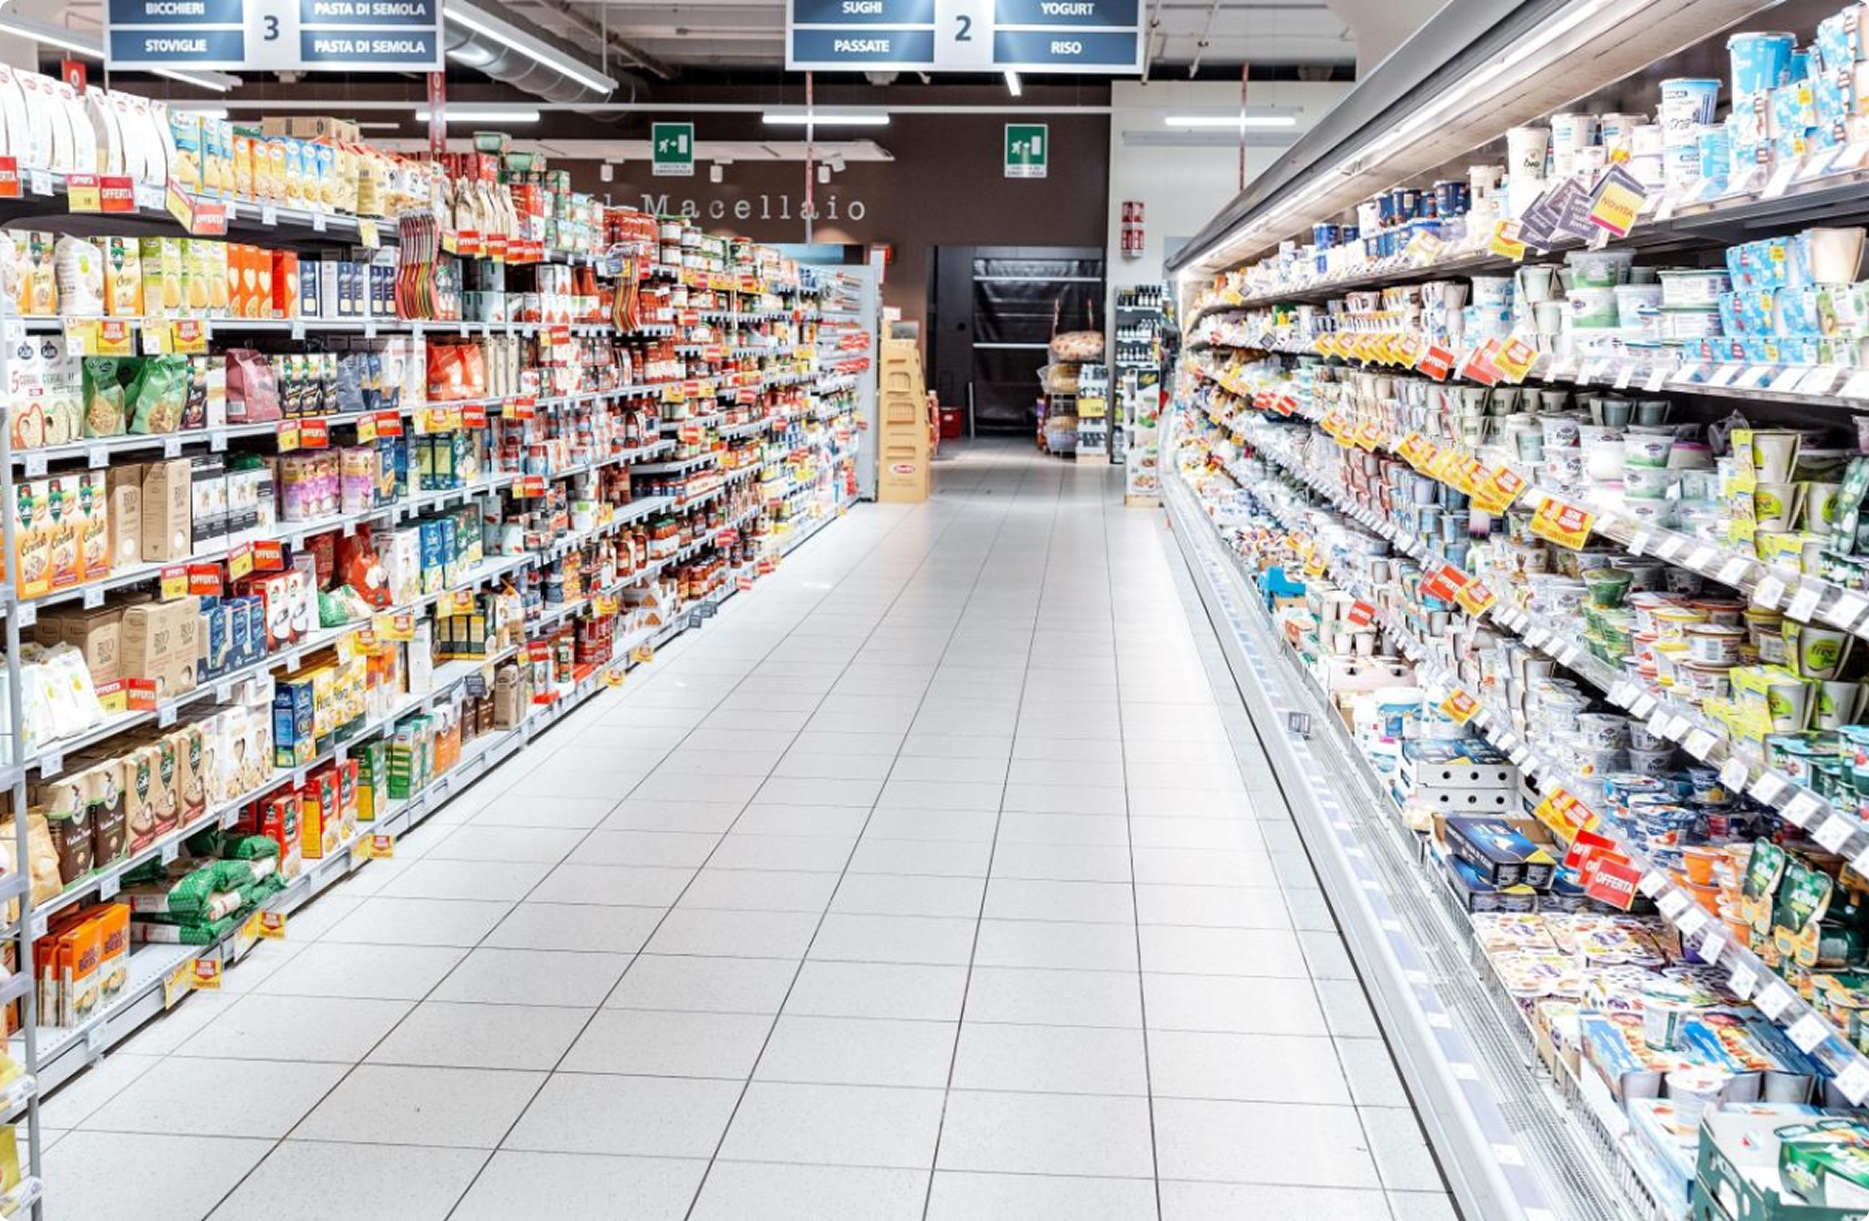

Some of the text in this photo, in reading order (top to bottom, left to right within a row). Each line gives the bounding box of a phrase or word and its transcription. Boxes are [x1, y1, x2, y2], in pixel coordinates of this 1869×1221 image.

[145, 1, 205, 15] BICCHIERI
[314, 2, 426, 16] PASTA DI SEMOLA
[842, 1, 882, 14] SUGHI
[1041, 2, 1094, 15] YOGURT
[263, 16, 280, 41] 3
[954, 15, 972, 41] 2
[145, 39, 207, 52] STOVIGLIE
[314, 40, 426, 53] PASTA DI SEMOLA
[834, 39, 890, 53] PASSATE
[1051, 41, 1082, 54] RISO
[640, 194, 866, 220] Macellaio
[1595, 872, 1634, 894] OFFERTA
